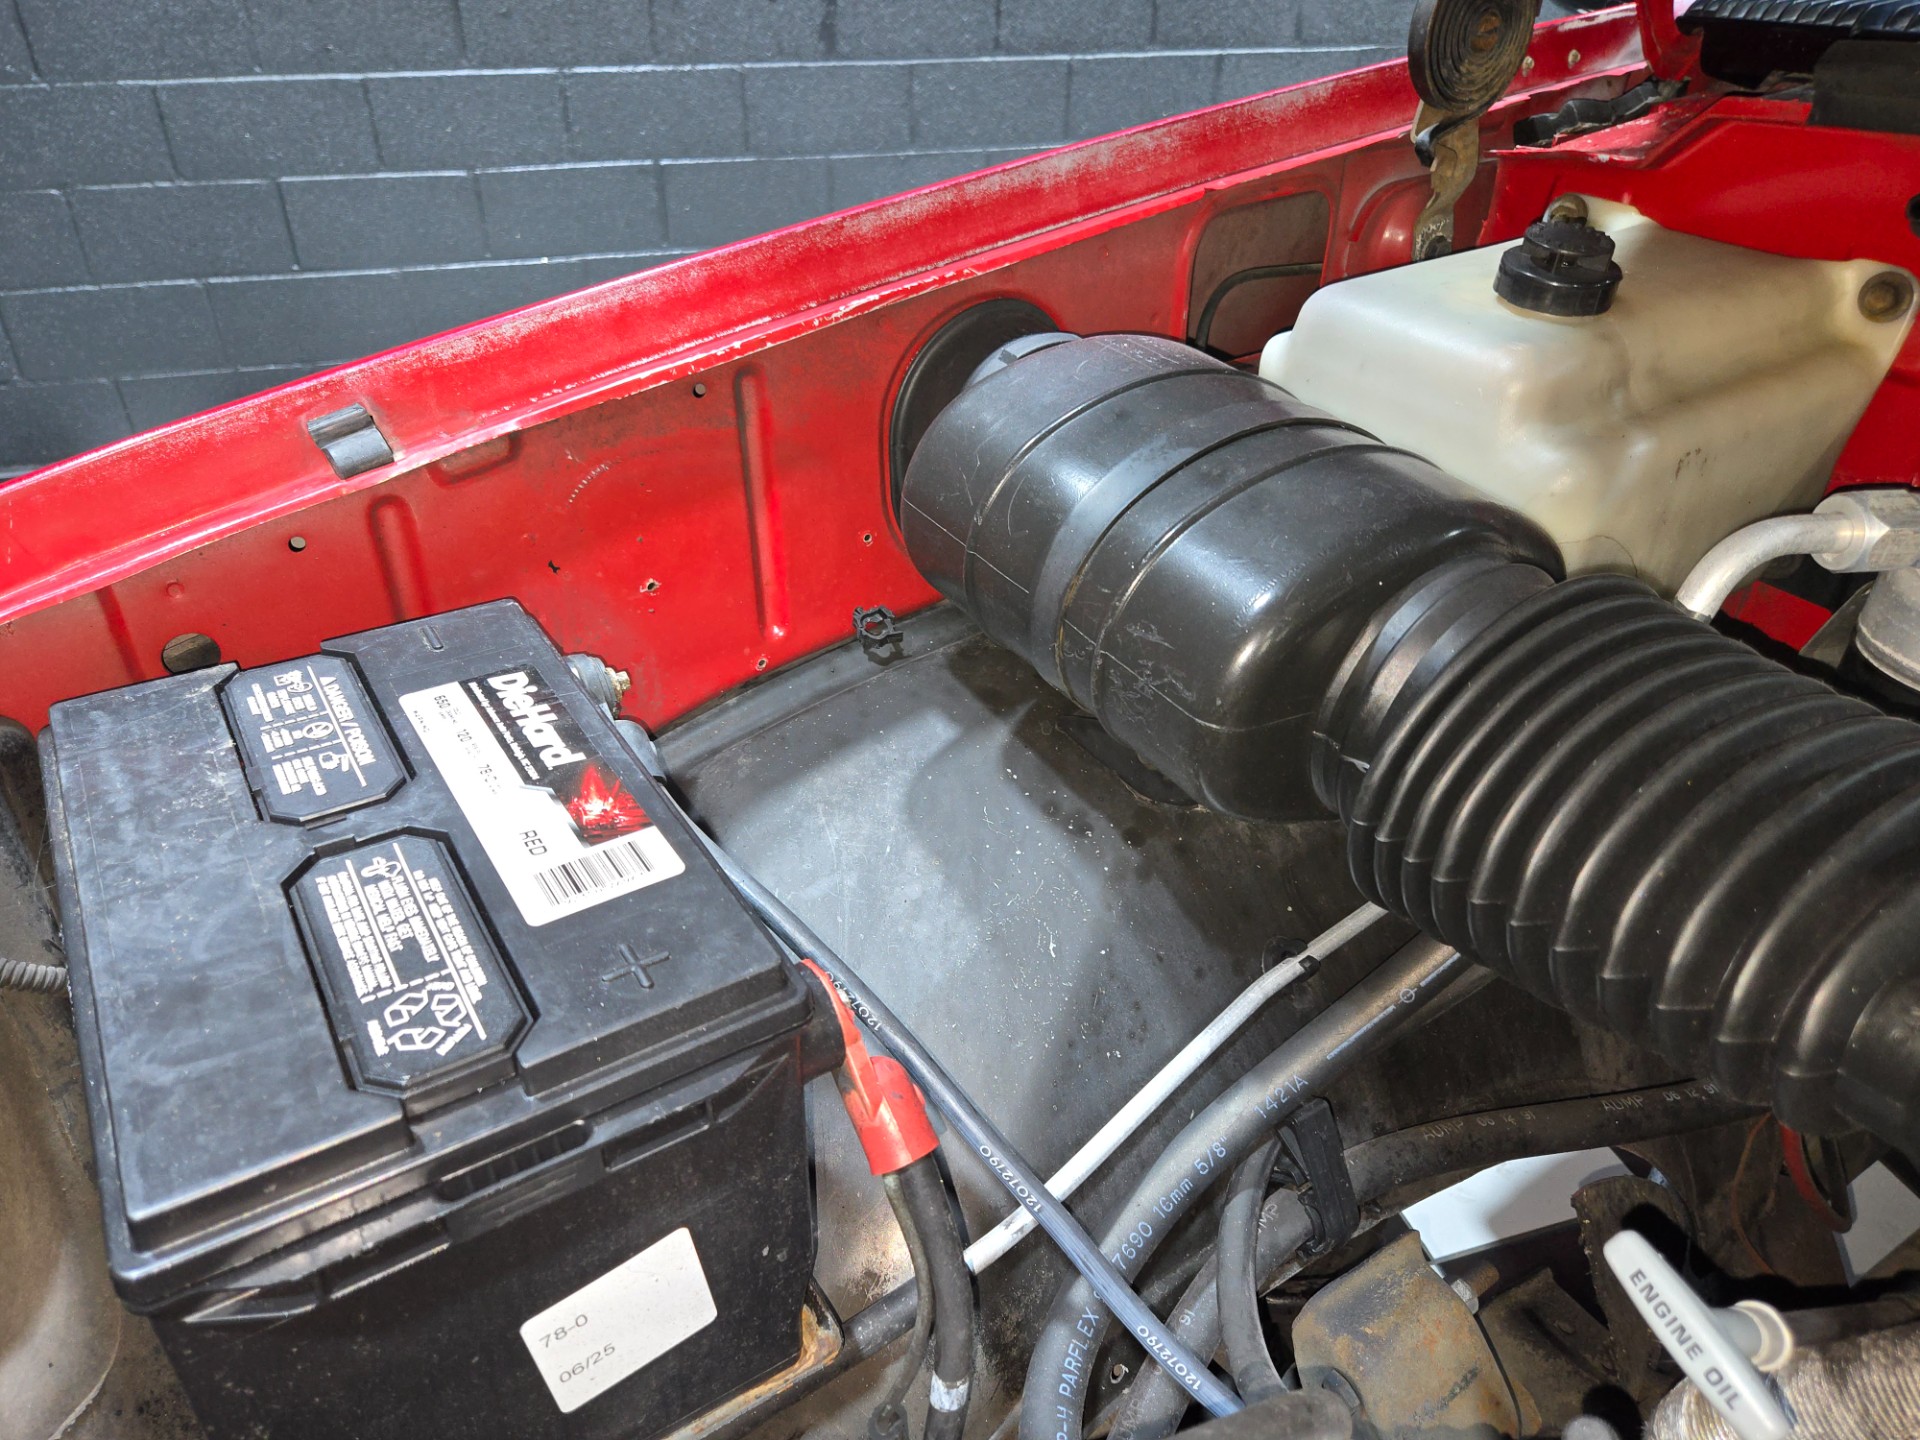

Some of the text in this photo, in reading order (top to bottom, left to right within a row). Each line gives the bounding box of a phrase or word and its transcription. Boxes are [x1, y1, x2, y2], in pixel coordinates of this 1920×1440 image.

[323, 684, 354, 721] DANGER
[345, 729, 377, 768] POISON
[433, 695, 452, 710] 650
[457, 728, 473, 743] 120
[487, 671, 587, 771] DieHard
[520, 830, 547, 856] RED
[400, 896, 420, 917] EYES
[977, 1143, 1043, 1214] 12072790
[1058, 1306, 1100, 1398] PARFLEX
[1152, 1178, 1194, 1219] 16mm
[1252, 1074, 1310, 1117] 1421A
[558, 1343, 616, 1384] 06/25
[1136, 1325, 1202, 1390] 12072790
[1629, 1268, 1743, 1411] ENGINE OIL
